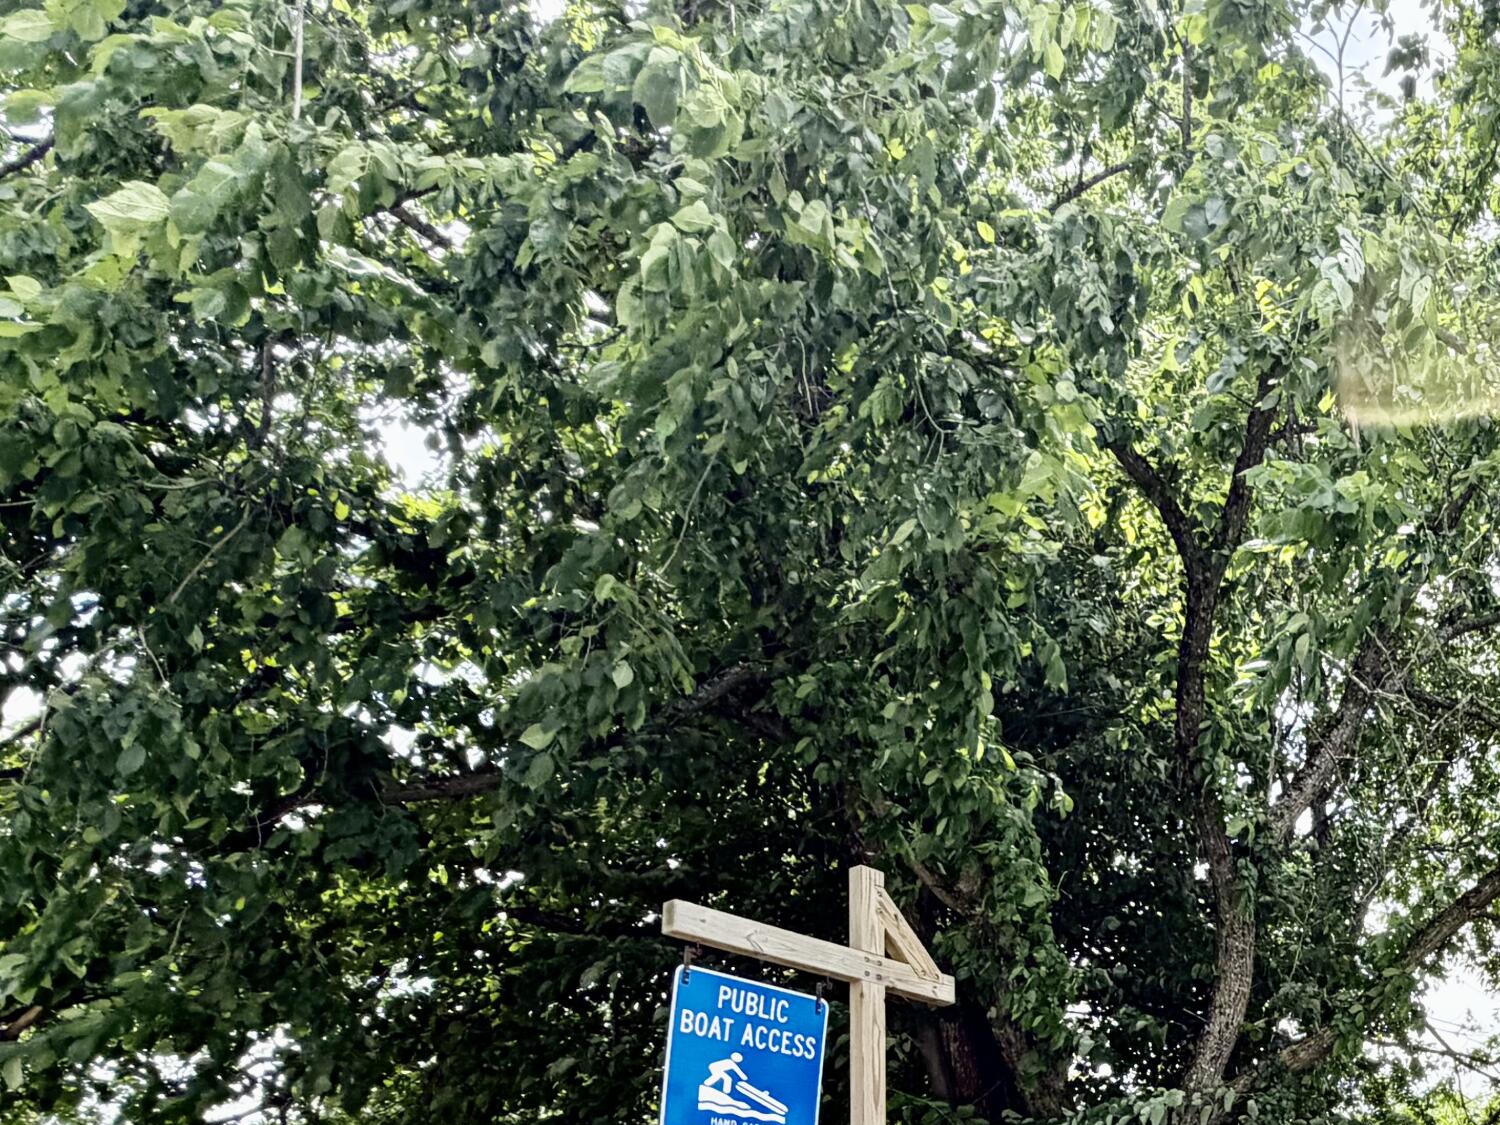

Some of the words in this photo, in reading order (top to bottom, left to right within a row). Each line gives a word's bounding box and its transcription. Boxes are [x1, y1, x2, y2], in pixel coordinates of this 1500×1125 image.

[718, 985, 789, 1023] PUBLIC
[680, 1009, 734, 1041] BOAT
[741, 1024, 816, 1060] ACCESS
